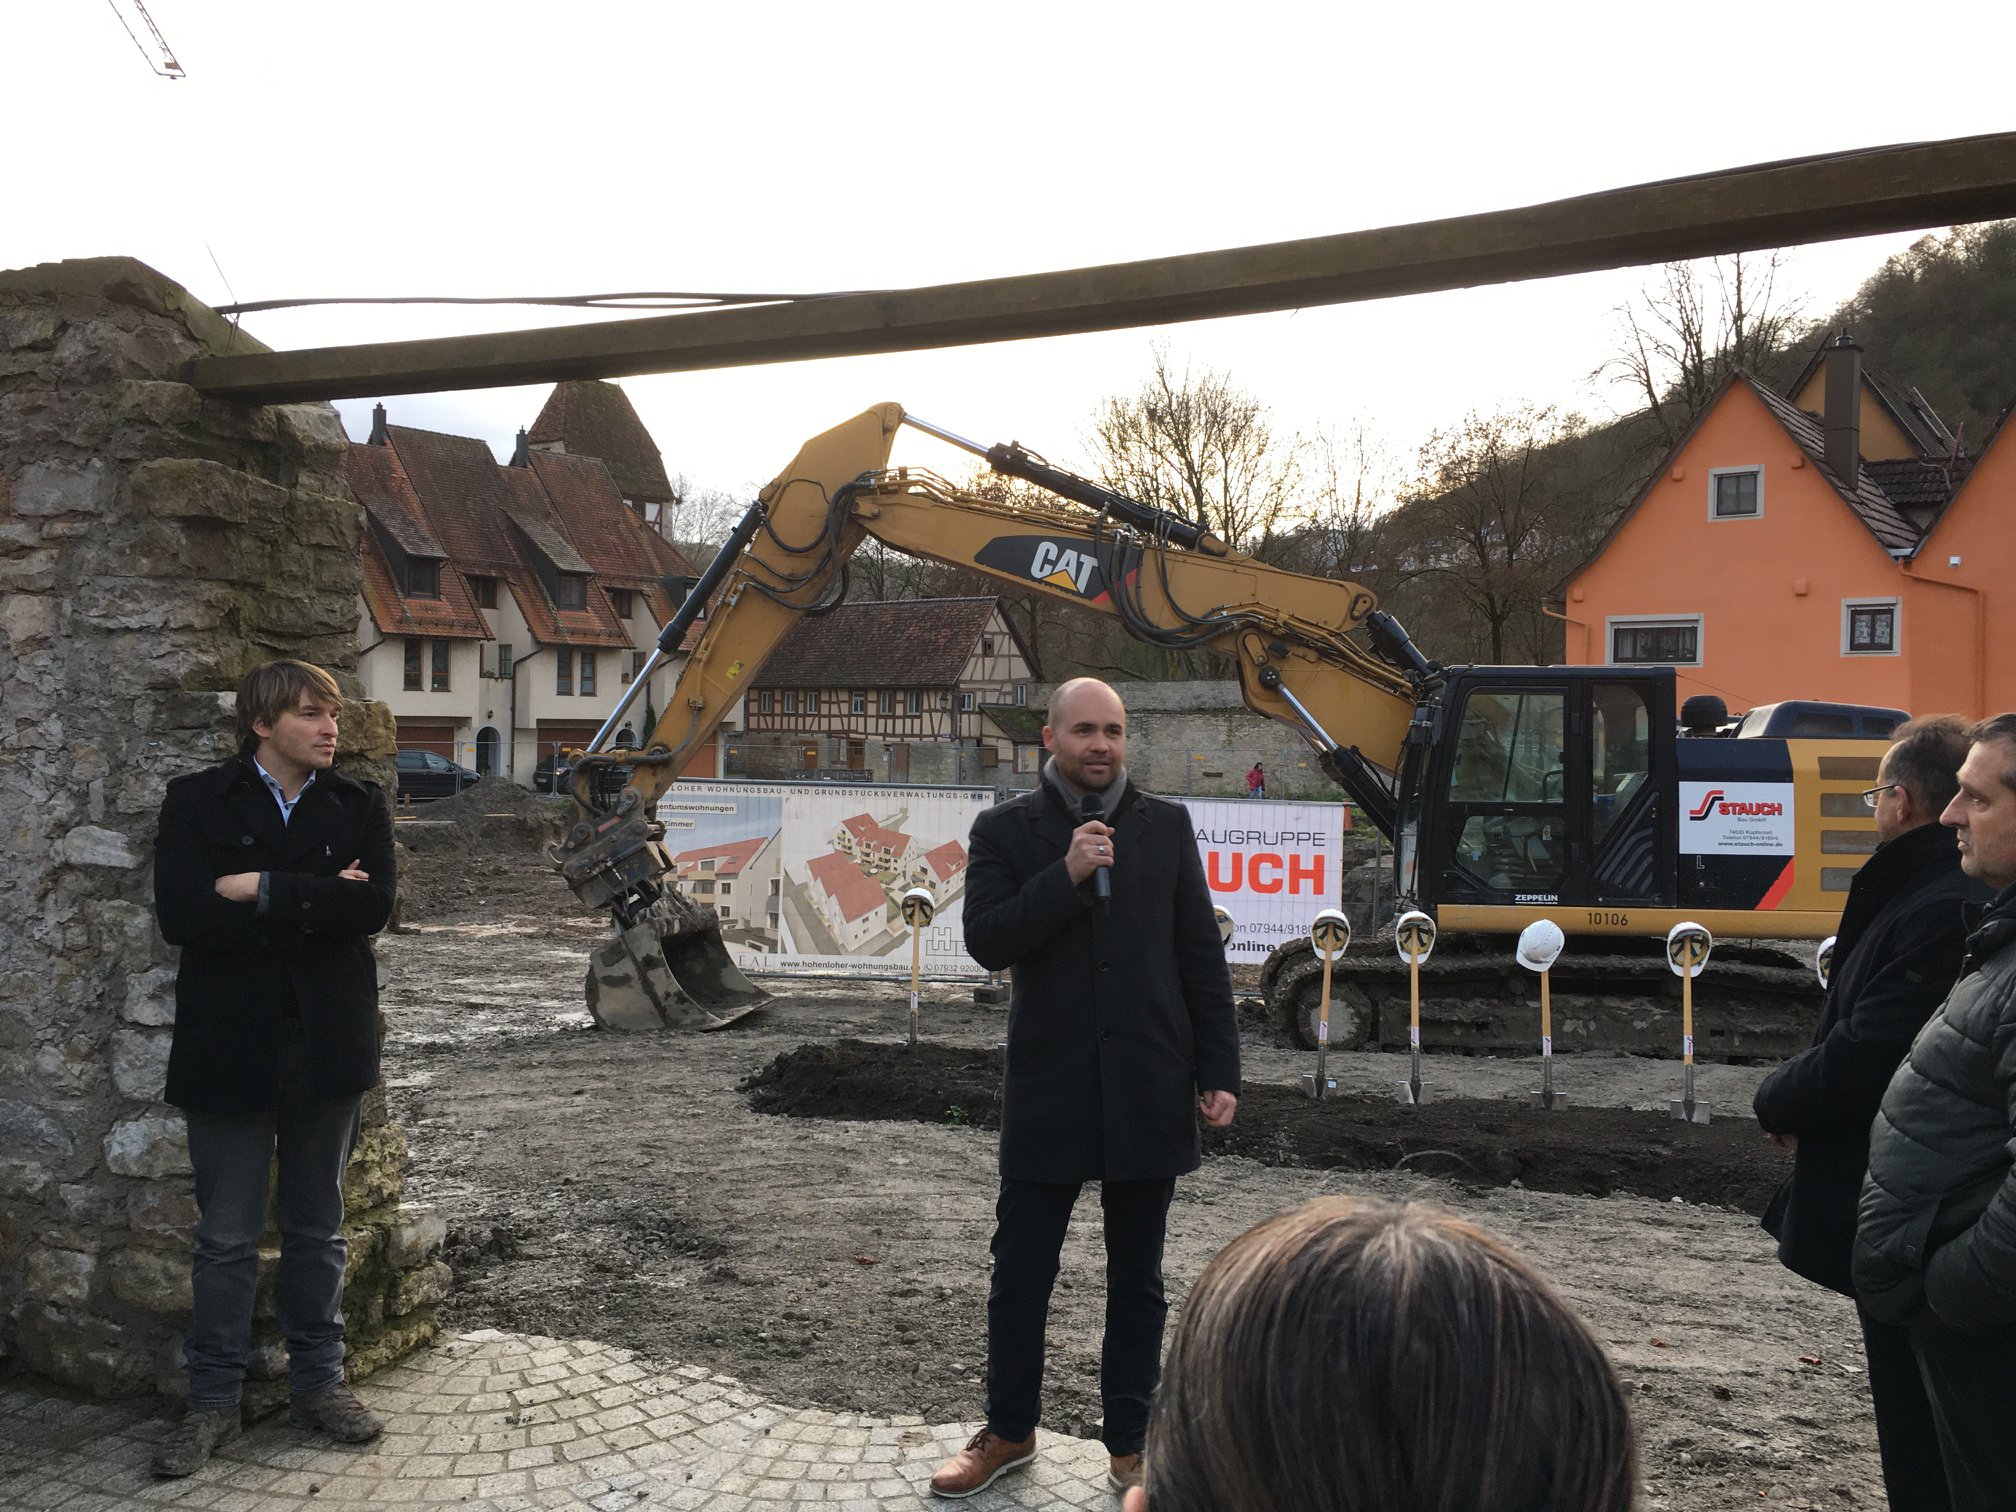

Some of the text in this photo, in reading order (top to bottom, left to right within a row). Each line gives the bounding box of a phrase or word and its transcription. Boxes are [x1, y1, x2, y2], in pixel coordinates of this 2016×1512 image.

[1030, 541, 1099, 594] CAT
[1719, 803, 1782, 815] STAUCH
[1195, 829, 1325, 846] AUGRUPPE
[1208, 851, 1325, 895] UCH
[1587, 912, 1629, 926] 10106
[933, 964, 958, 973] 07932
[960, 964, 984, 973] 92000
